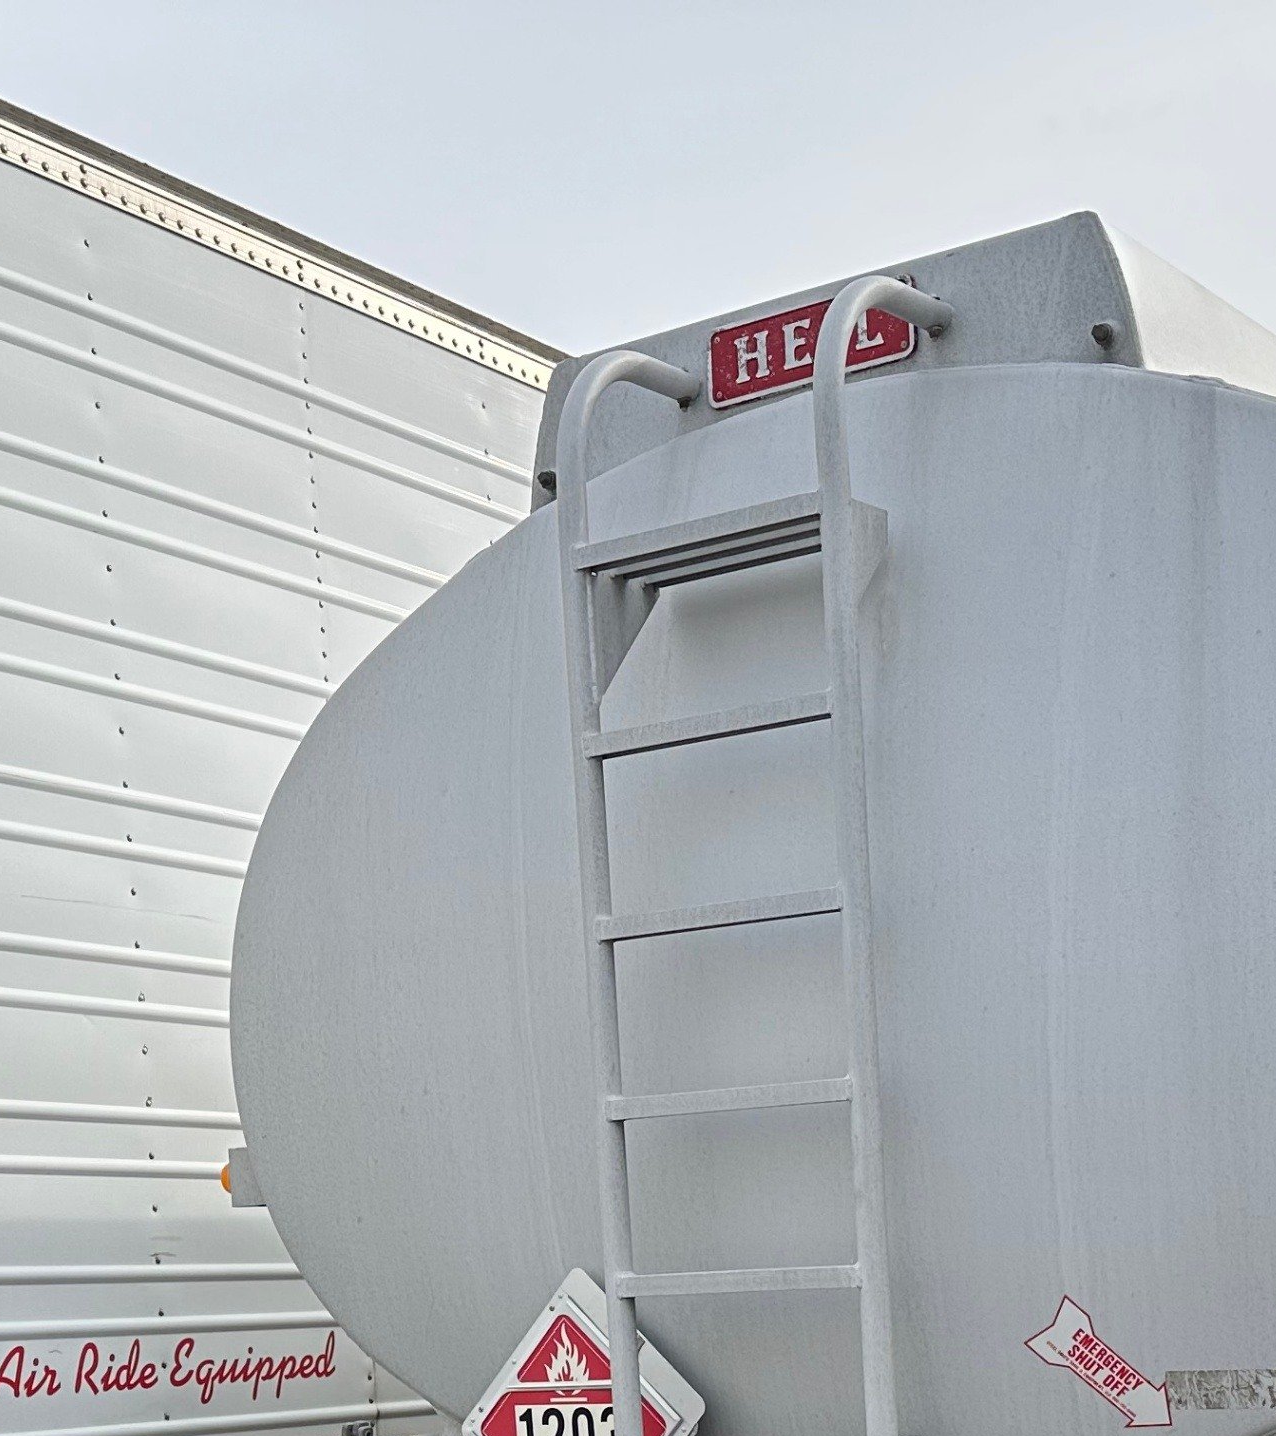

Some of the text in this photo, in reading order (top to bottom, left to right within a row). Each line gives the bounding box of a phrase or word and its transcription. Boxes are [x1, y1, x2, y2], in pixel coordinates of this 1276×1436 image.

[734, 310, 884, 384] HEL
[74, 1337, 159, 1396] Ride
[169, 1329, 337, 1405] Equipped
[1068, 1345, 1130, 1397] SHUT OFF
[1072, 1328, 1144, 1390] EMERGENCY
